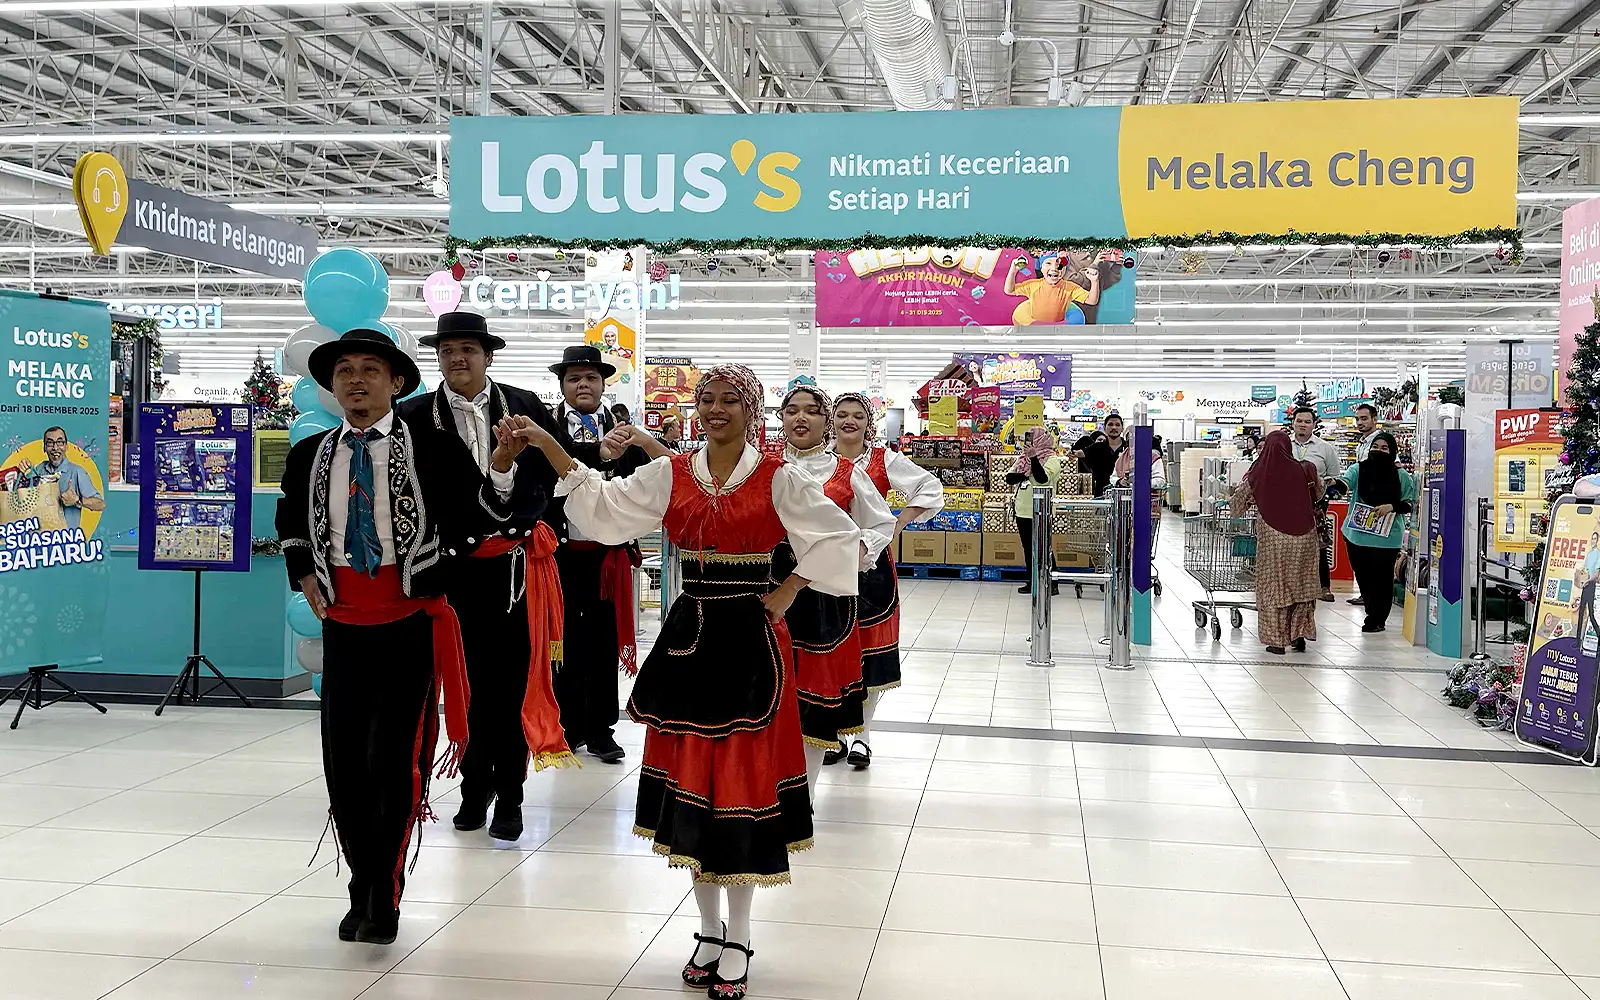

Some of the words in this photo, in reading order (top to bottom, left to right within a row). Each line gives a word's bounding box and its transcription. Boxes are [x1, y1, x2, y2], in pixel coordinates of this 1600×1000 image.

[829, 151, 931, 177] Nikmati
[939, 150, 1070, 175] Keceriaan
[1147, 152, 1313, 191] Melaka
[1328, 149, 1475, 195] Cheng
[481, 139, 802, 214] Lotus's
[827, 187, 909, 216] Setiap
[917, 185, 971, 210] Hari
[135, 199, 217, 245] Khidmat
[222, 222, 305, 266] Pelanggan
[1570, 227, 1588, 255] Beli
[1590, 221, 1600, 249] di
[877, 271, 916, 285] AKHIR
[917, 271, 965, 289] TAHUN!
[1569, 257, 1600, 287] Online
[468, 269, 681, 320] Ceria-yah!
[13, 327, 89, 349] Lotus's
[8, 360, 93, 381] MELAKA
[15, 380, 86, 399] CHENG
[193, 387, 231, 397] Organik,
[1, 404, 20, 413] Dari
[22, 405, 33, 413] 18
[34, 405, 78, 415] DISEMBER
[80, 407, 99, 415] 2025
[1500, 413, 1540, 434] PWP
[0, 516, 39, 536] RASAI
[6, 528, 85, 550] SUASANA
[1551, 537, 1588, 560] FREE
[0, 540, 103, 572] BAHARU!
[1549, 558, 1577, 569] DELIVERY
[1547, 648, 1560, 662] my
[1559, 653, 1577, 664] Lotus's
[1539, 676, 1557, 687] JANJI
